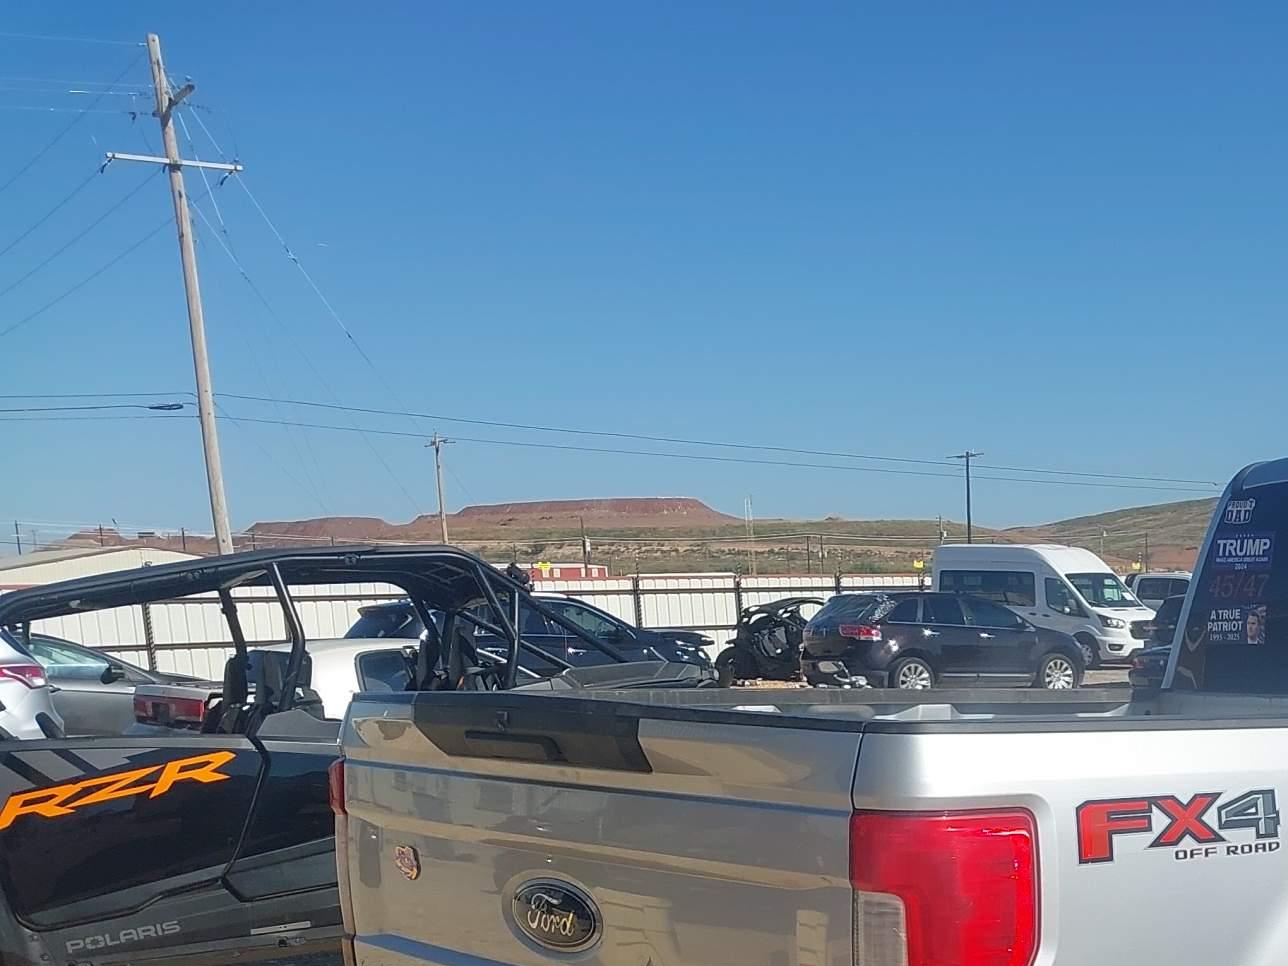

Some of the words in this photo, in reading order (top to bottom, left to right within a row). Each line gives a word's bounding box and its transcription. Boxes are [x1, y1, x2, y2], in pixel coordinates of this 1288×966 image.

[1226, 509, 1251, 523] DAD
[1216, 538, 1271, 557] TRUMP
[1208, 572, 1270, 599] 45/47
[1207, 620, 1243, 632] PATRIOT
[1210, 610, 1217, 621] A
[1217, 608, 1241, 620] TRUE
[0, 750, 237, 831] RZR
[1076, 788, 1281, 865] FX4
[1175, 847, 1218, 861] OFF
[1226, 841, 1281, 857] ROAD
[525, 892, 578, 938] Ford
[65, 920, 182, 954] POLARIS
